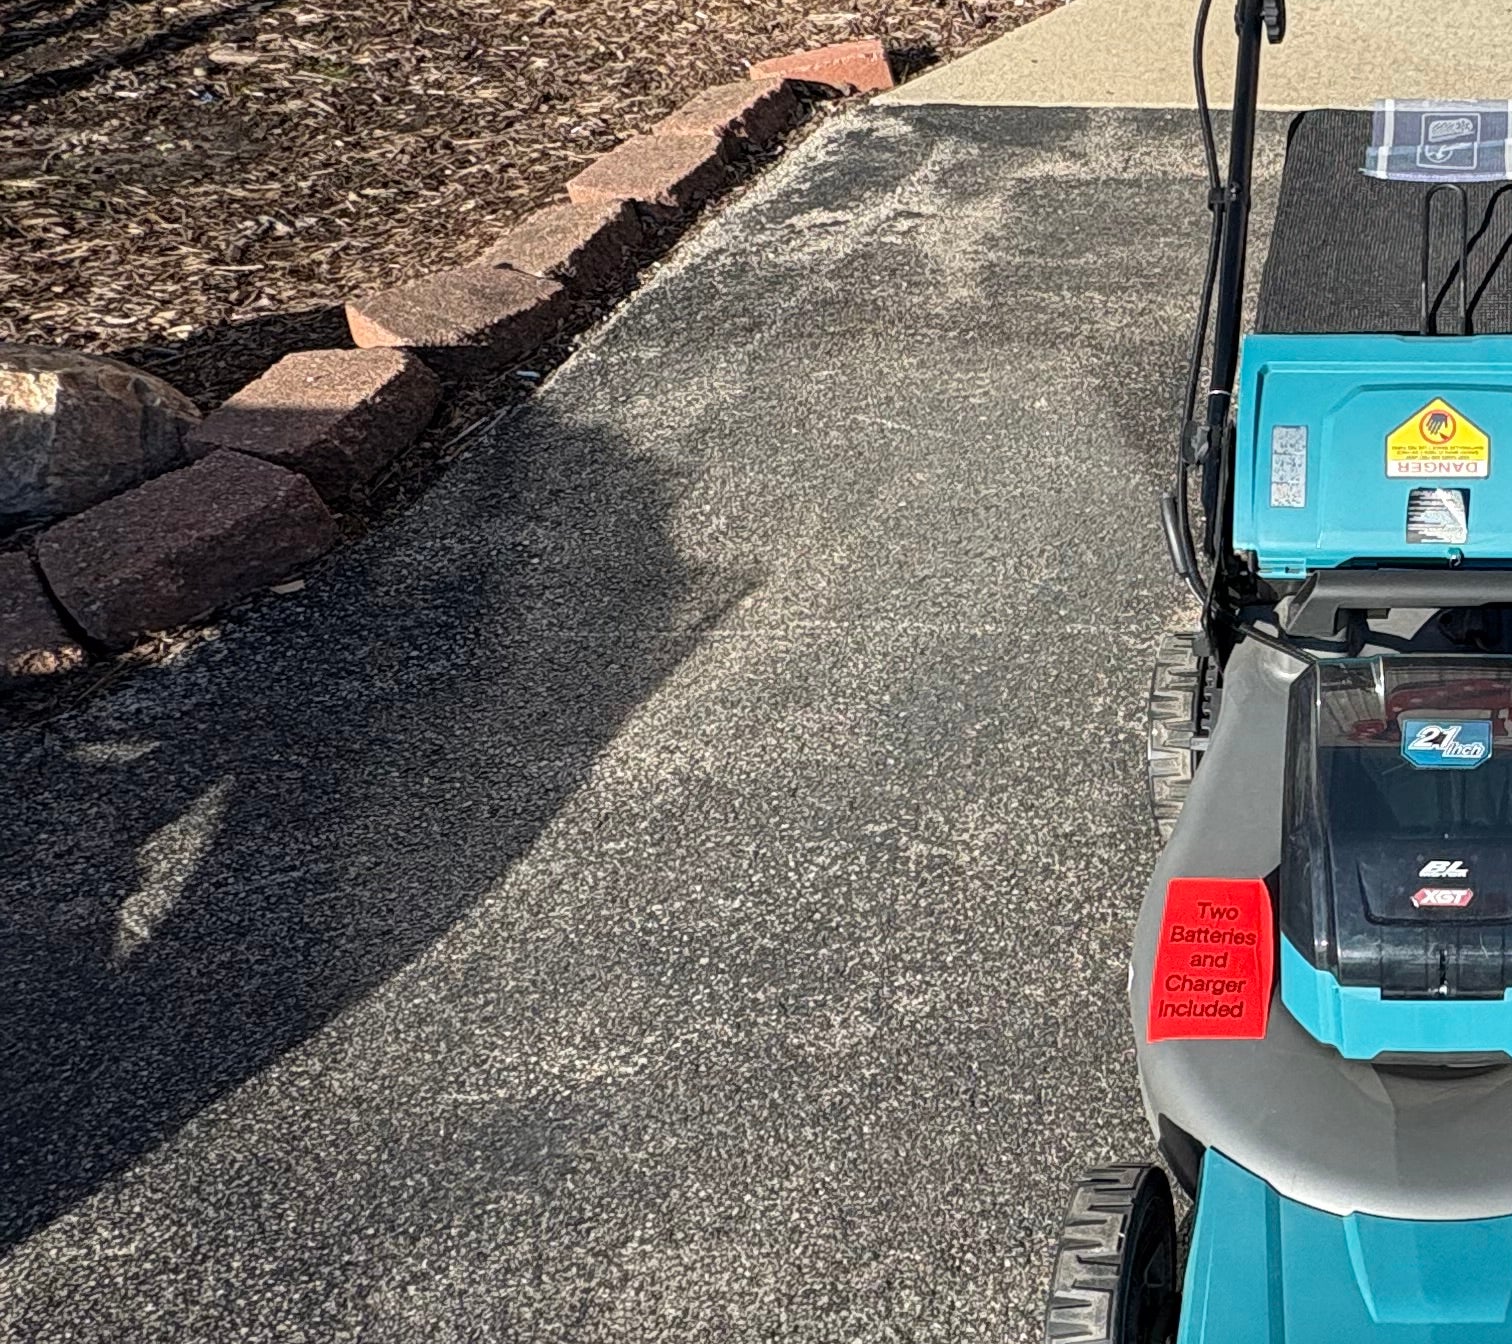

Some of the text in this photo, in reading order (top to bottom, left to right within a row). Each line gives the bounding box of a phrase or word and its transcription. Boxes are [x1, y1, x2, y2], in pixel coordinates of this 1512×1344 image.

[1397, 462, 1478, 473] DANGER
[1408, 725, 1461, 750] 21
[1420, 860, 1469, 873] BL
[1419, 889, 1468, 904] XGT
[1197, 902, 1239, 920] Two
[1170, 925, 1257, 945] Batteries
[1190, 951, 1229, 968] and
[1165, 974, 1247, 995] Charger
[1158, 1000, 1244, 1018] Included
